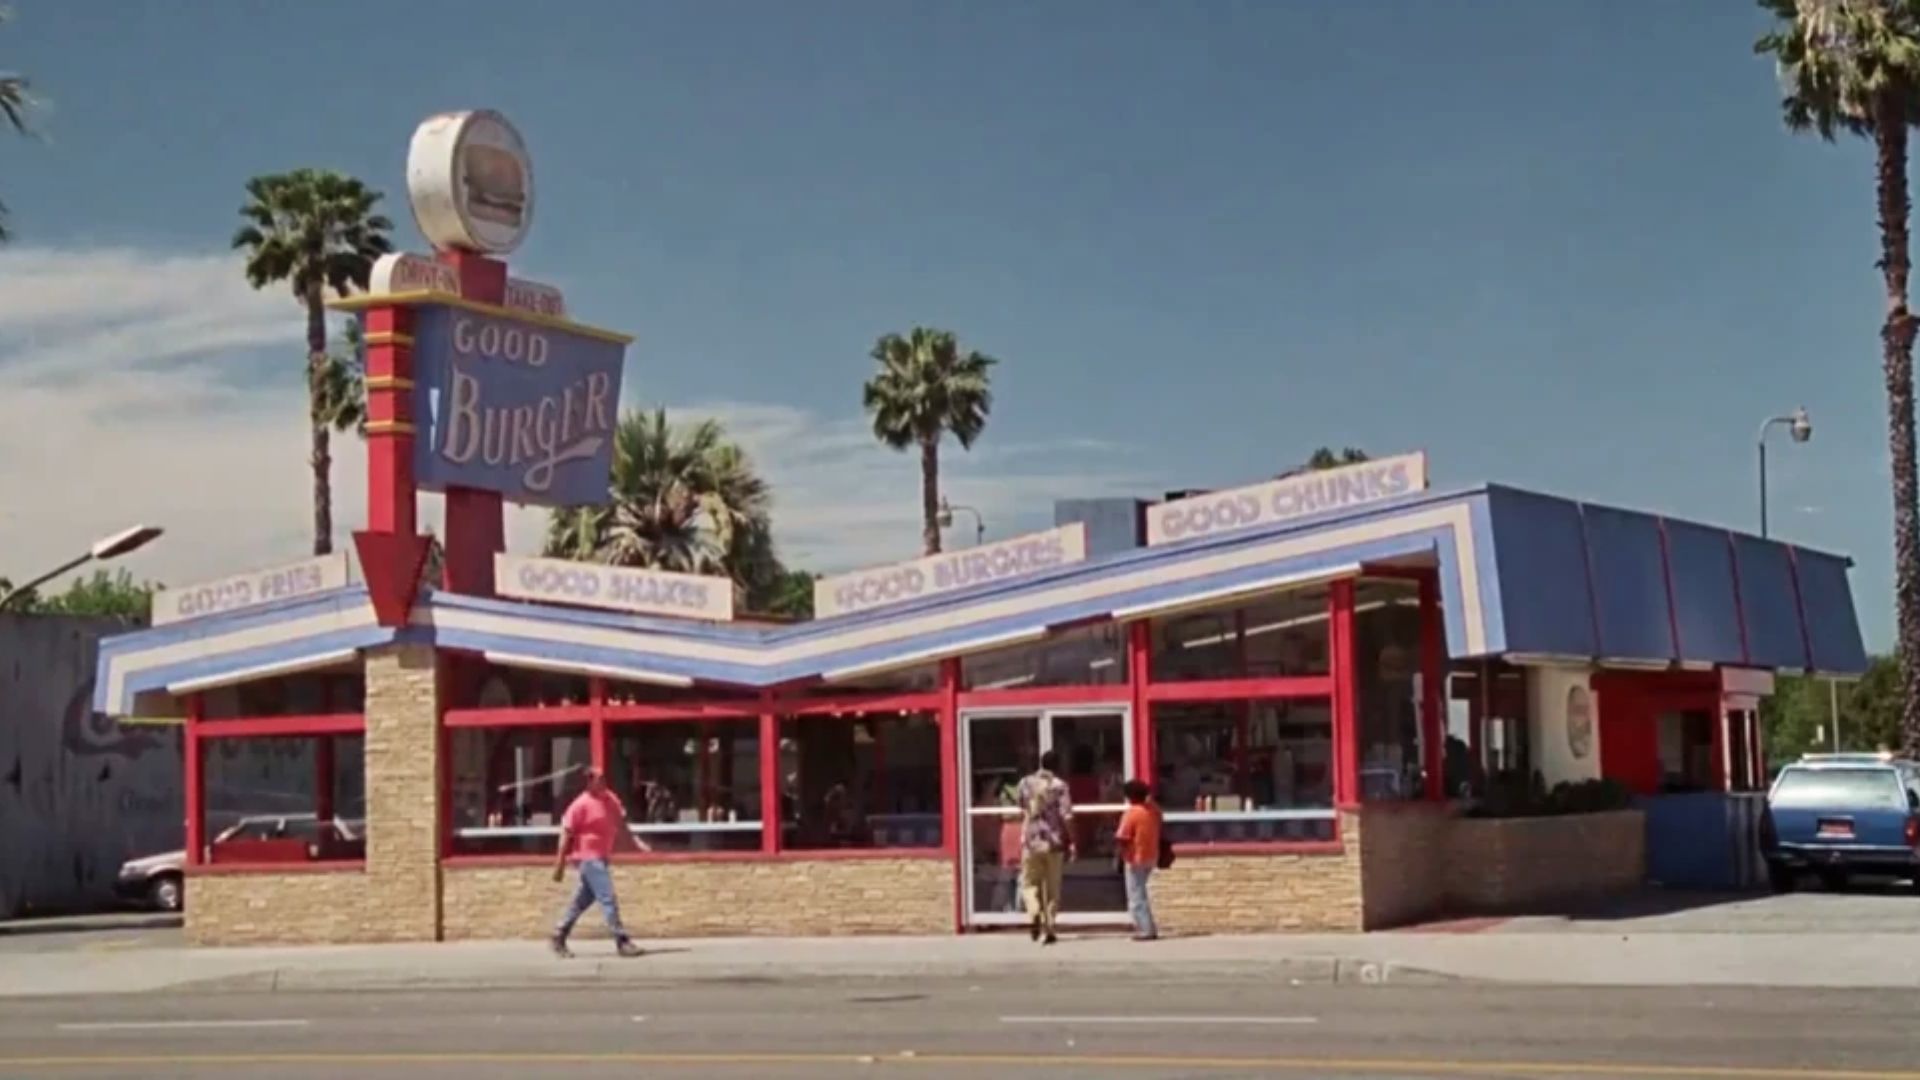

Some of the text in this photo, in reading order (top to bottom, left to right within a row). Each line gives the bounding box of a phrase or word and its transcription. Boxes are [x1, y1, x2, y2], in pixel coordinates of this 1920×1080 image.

[455, 319, 548, 367] GOOD
[443, 366, 609, 491] BURGER
[1161, 463, 1408, 537] GOOD CHUNKS
[519, 563, 599, 597] GOOD
[836, 568, 924, 609] GOOD
